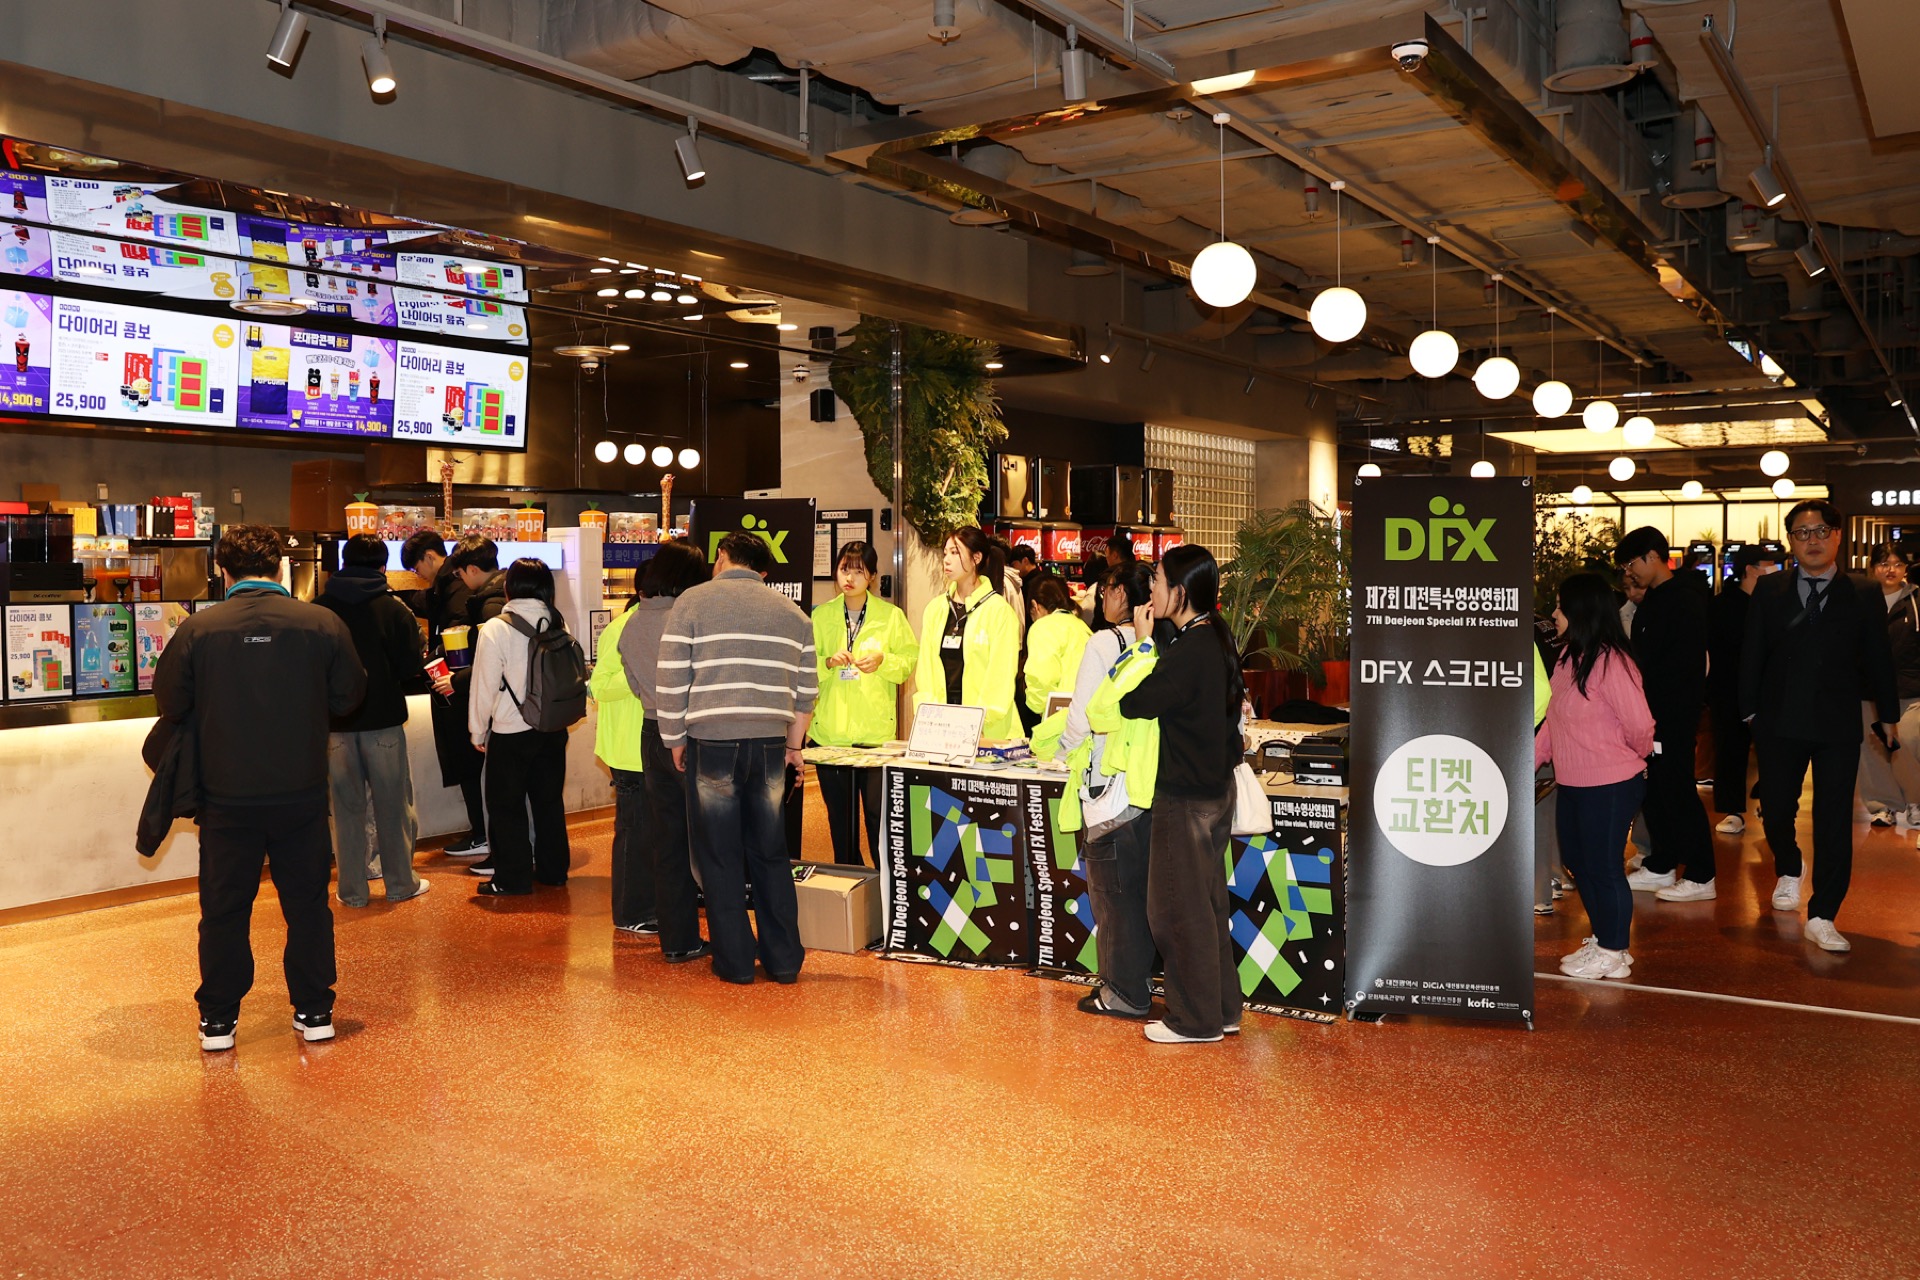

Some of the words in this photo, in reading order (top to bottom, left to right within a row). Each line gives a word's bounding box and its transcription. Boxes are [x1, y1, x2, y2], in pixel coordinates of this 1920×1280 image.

[59, 314, 117, 337] 다이어리
[123, 321, 151, 340] 콤보
[400, 355, 442, 374] 다이어리
[445, 360, 465, 376] 콤보
[56, 392, 106, 411] 25,900
[355, 420, 382, 433] 14,900
[397, 420, 433, 434] 25,900
[517, 520, 543, 533] POP
[1365, 586, 1399, 610] 제7회
[1404, 586, 1519, 612] 대전특수영상영화제
[1366, 615, 1382, 625] 7TH
[1385, 615, 1425, 627] Daejeon
[1426, 616, 1464, 628] Special
[1466, 617, 1477, 627] FX
[1479, 616, 1519, 628] Festival
[1360, 659, 1413, 685] DFX
[1422, 659, 1523, 688] 스크리닝
[1407, 757, 1472, 794] 티켓
[890, 771, 906, 819] Festival
[1026, 783, 1043, 833] Festival
[1388, 797, 1489, 835] 교환처
[890, 819, 905, 835] FX
[1029, 833, 1046, 848] FX
[892, 835, 909, 878] Special
[1033, 848, 1053, 893] Special
[892, 878, 910, 926] Daejeon
[1037, 893, 1055, 944] Daejeon
[889, 926, 907, 950] 7TH
[1038, 944, 1054, 967] 7TH
[1467, 997, 1496, 1009] kofic
